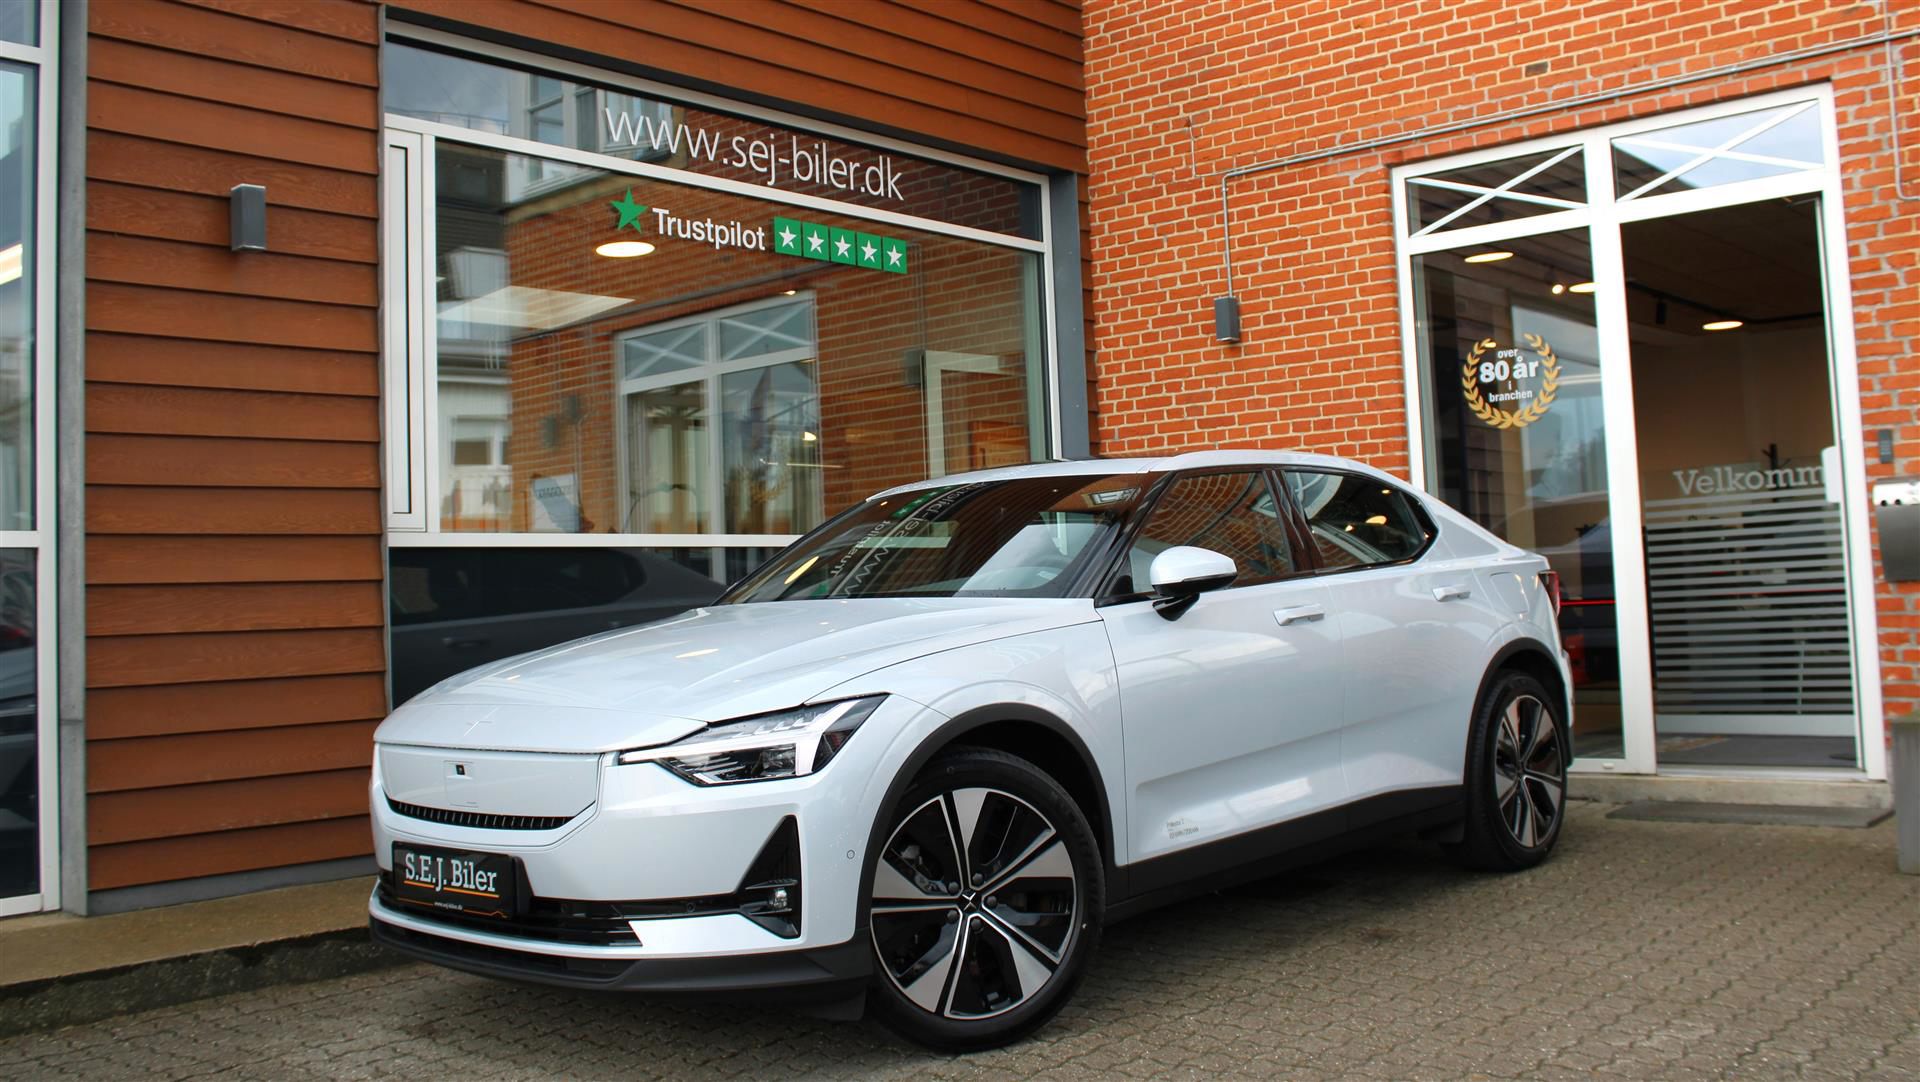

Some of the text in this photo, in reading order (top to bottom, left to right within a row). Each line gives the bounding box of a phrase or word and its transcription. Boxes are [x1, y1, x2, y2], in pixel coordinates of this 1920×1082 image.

[605, 107, 904, 200] www.sej-biler.dk
[652, 207, 766, 251] Trustpilot
[1497, 348, 1519, 359] over
[1479, 355, 1539, 383] 80 år
[1489, 390, 1533, 403] branchen
[1508, 381, 1512, 390] i
[405, 852, 497, 892] S.E.J. Biler
